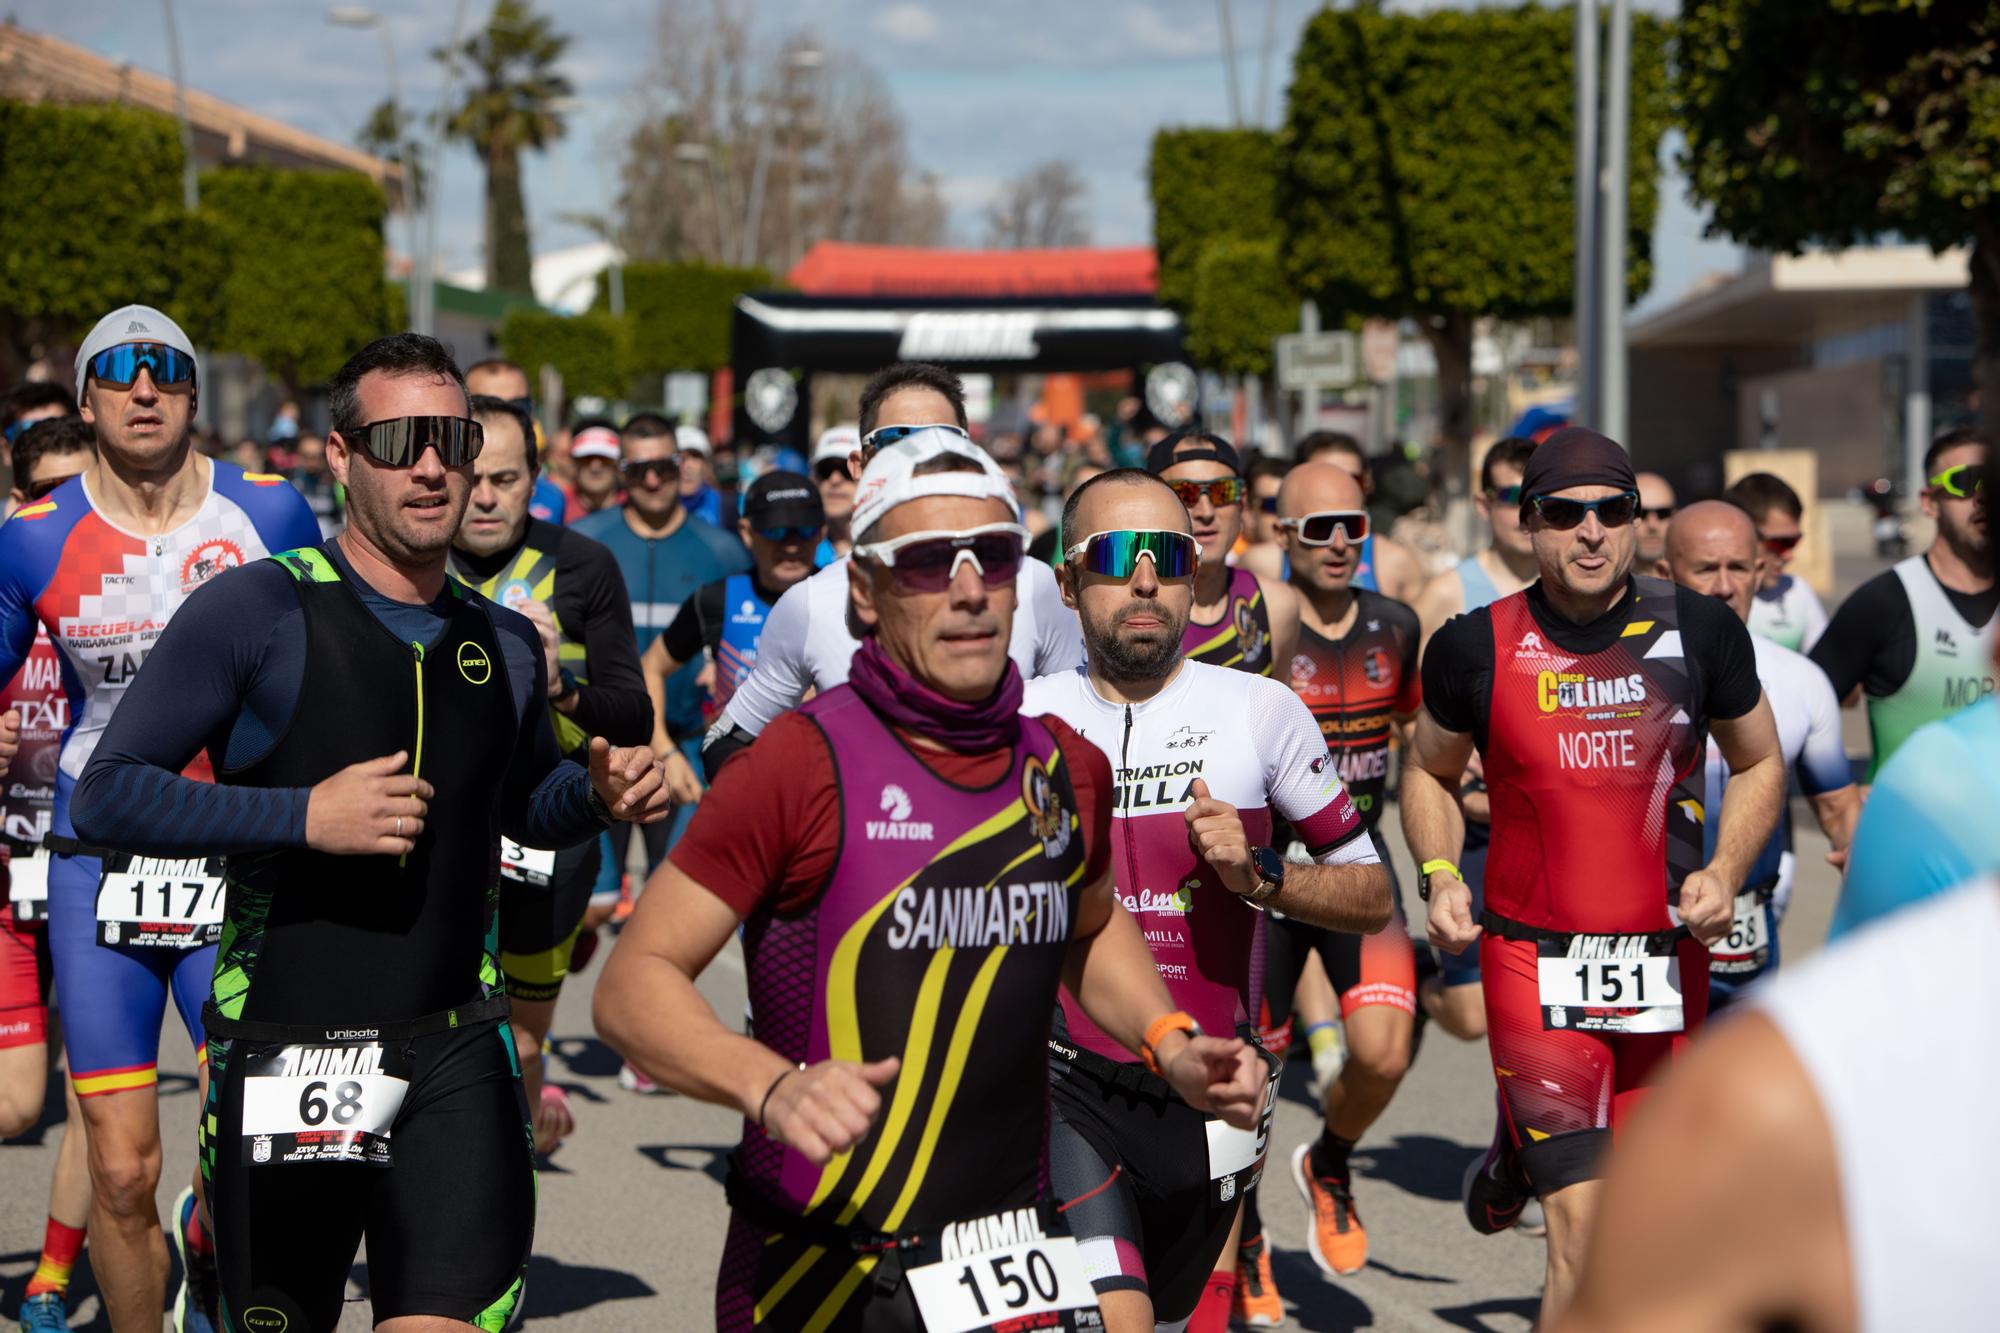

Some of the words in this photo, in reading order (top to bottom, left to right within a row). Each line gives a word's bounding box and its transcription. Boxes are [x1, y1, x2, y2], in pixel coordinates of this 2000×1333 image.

[104, 576, 135, 585] TACTIC
[66, 619, 155, 638] ESCUELA
[1586, 711, 1616, 721] SPORT
[1558, 729, 1636, 770] NORTE
[1115, 759, 1204, 782] TRIATLON
[866, 821, 934, 841] VIATOR
[127, 855, 208, 878] ANIMAL
[131, 881, 204, 918] 117
[887, 880, 1069, 950] SANMARTIN
[1726, 916, 1756, 949] 68
[1575, 963, 1645, 1003] 151
[280, 1046, 384, 1077] ANIMAL
[299, 1080, 363, 1126] 68
[283, 1153, 302, 1161] Villa
[316, 1151, 340, 1159] Torre
[940, 1206, 1047, 1263] ANIMAL
[958, 1249, 1059, 1317] 150
